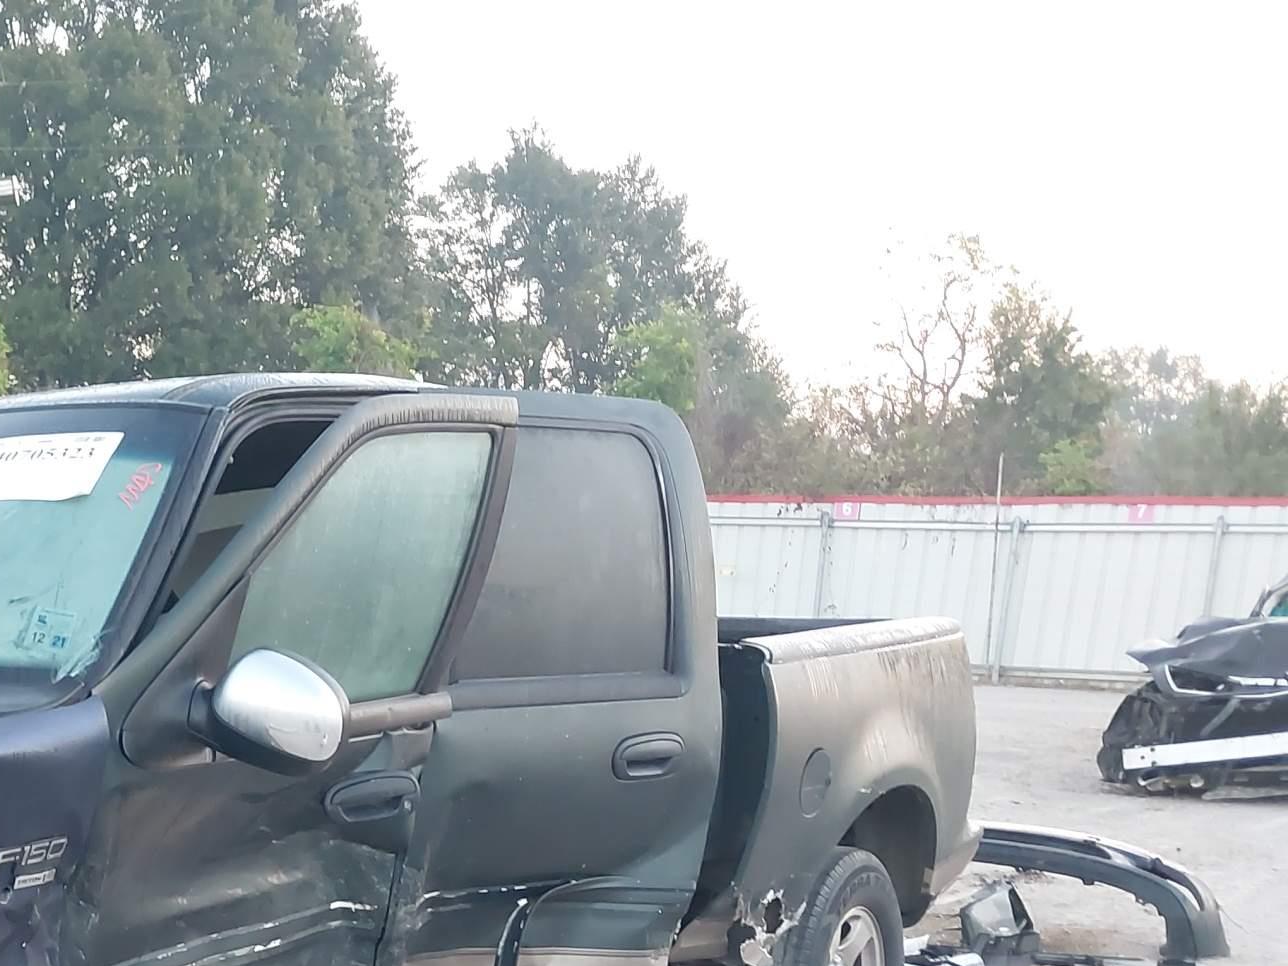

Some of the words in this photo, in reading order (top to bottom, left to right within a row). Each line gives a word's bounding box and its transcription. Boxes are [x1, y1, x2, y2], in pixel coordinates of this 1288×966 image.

[842, 503, 852, 516] 6
[1136, 504, 1148, 519] 7
[32, 632, 46, 644] 12
[52, 635, 66, 648] 21
